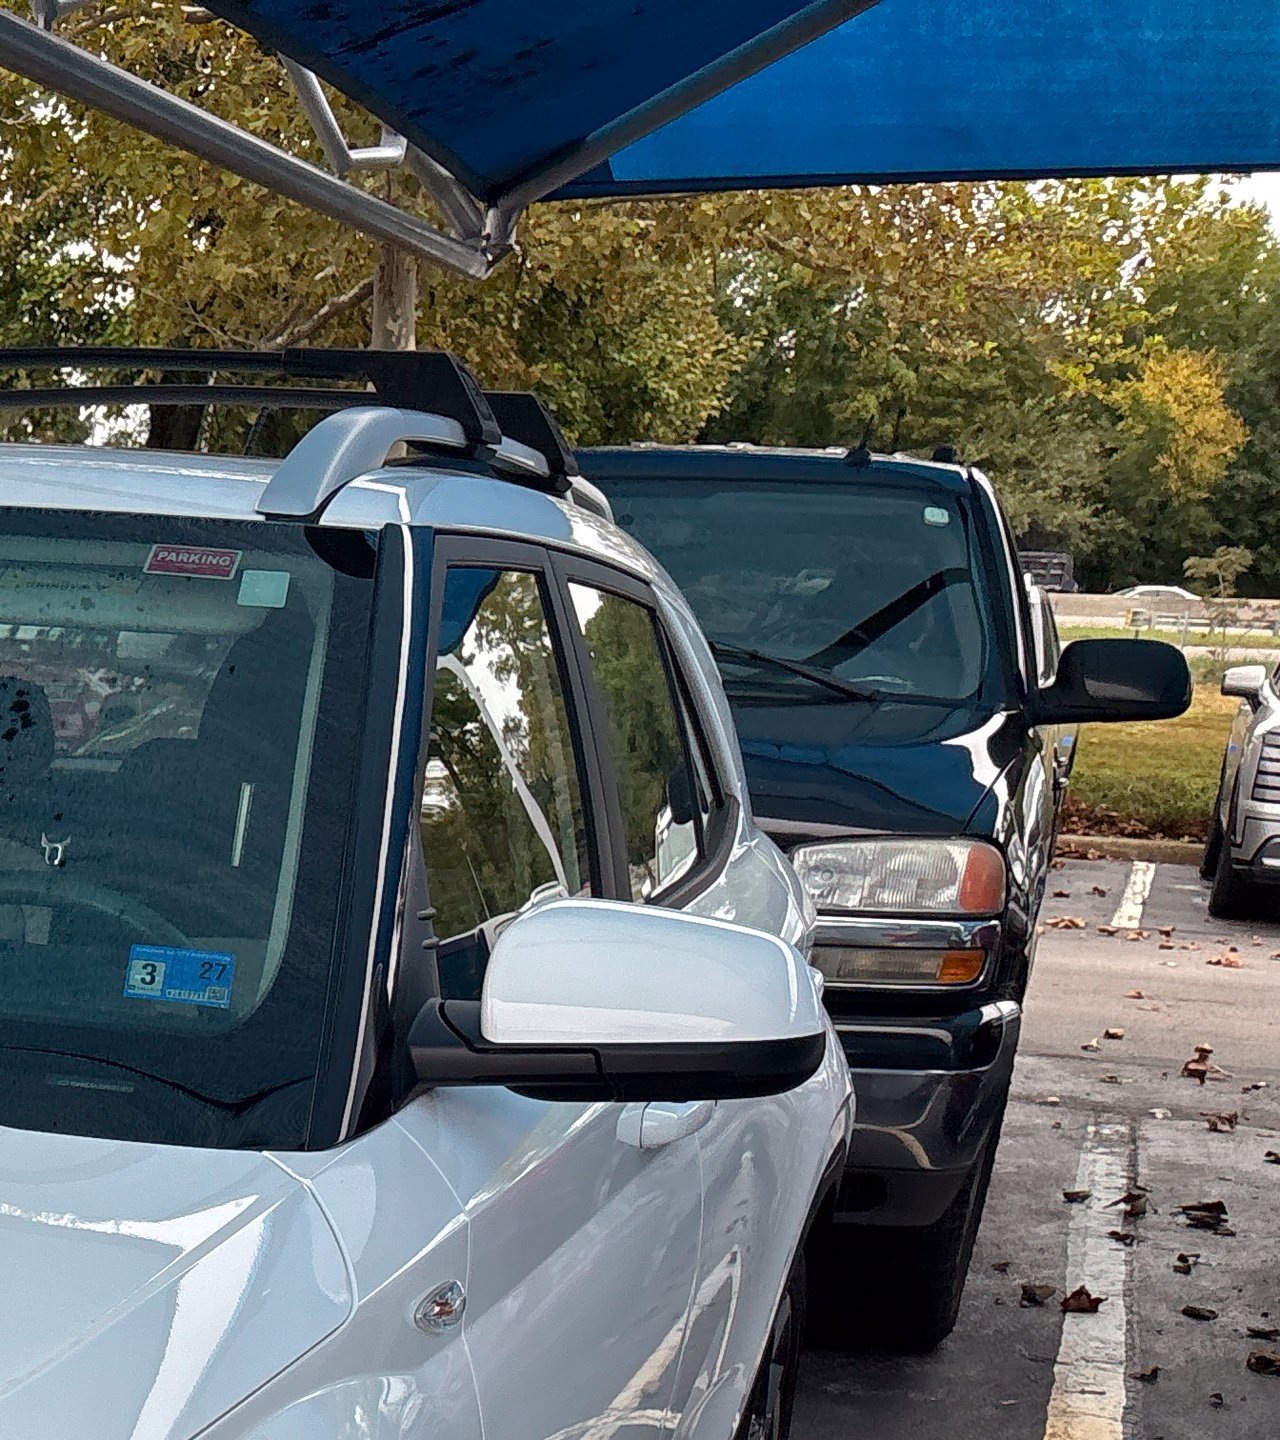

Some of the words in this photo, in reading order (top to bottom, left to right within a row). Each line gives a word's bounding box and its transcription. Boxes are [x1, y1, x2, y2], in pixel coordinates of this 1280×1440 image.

[156, 551, 231, 566] PARKING
[139, 962, 158, 986] 3
[198, 961, 229, 982] 27
